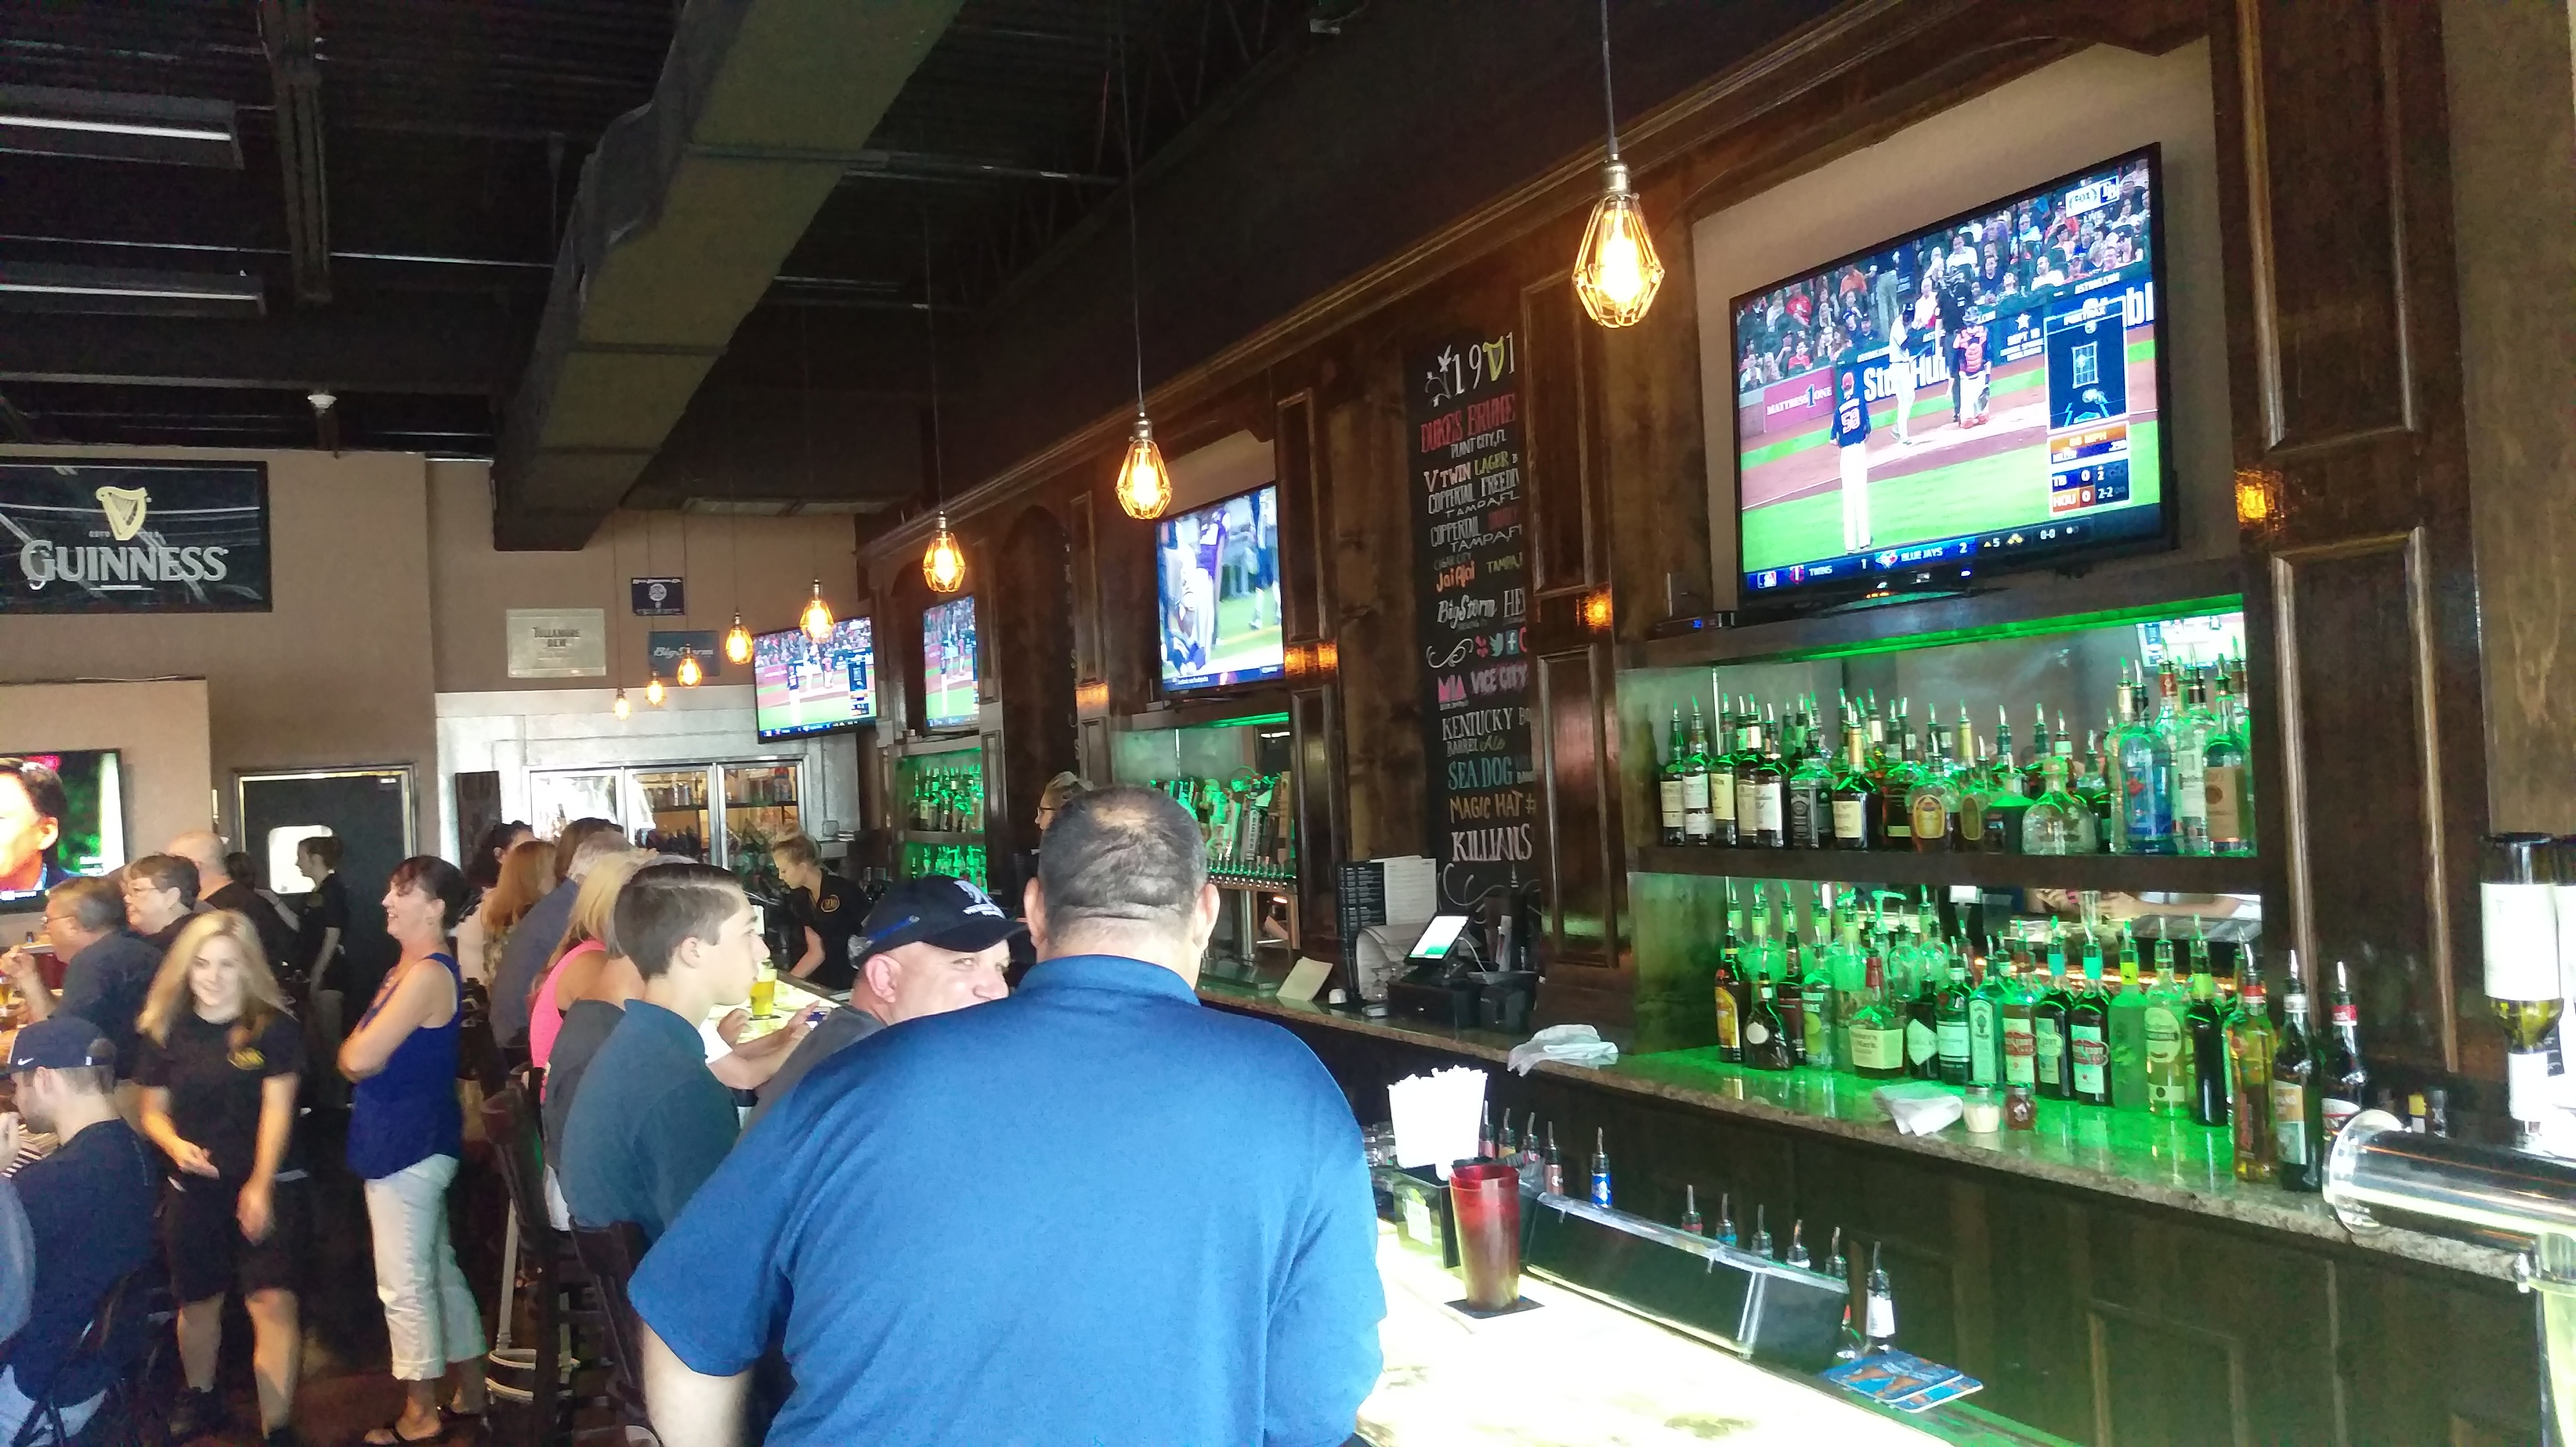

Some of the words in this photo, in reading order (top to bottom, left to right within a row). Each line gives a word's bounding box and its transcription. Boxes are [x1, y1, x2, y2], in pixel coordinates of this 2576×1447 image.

[1767, 394, 1808, 416] MATTRESS
[1814, 387, 1832, 400] ONE
[1450, 437, 1477, 459] PLANT
[1423, 469, 1439, 492] V
[1440, 462, 1472, 488] TWIN
[1474, 451, 1510, 475] LAGER
[2052, 475, 2067, 486] TB
[2081, 470, 2090, 481] 0
[2097, 471, 2105, 481] 2
[2053, 494, 2076, 507] HOU
[2081, 490, 2091, 502] 0
[2097, 486, 2113, 499] 2-2
[1993, 538, 2000, 548] 5
[2040, 529, 2056, 540] 0-0
[1901, 549, 1922, 562] BLUE
[1922, 546, 1943, 559] JAYS
[1959, 542, 1967, 554] 2
[20, 539, 229, 582] GUINNESS
[1808, 565, 1833, 577] TWINS
[1861, 558, 1866, 569] 1
[1470, 668, 1498, 694] VICE
[1442, 707, 1514, 741] KENTUCKY
[1448, 760, 1479, 790] SEA
[1481, 756, 1513, 788] DOG
[1450, 795, 1491, 824] MAGIC
[1494, 789, 1524, 817] HAT
[1451, 823, 1533, 862] KILLIANS
